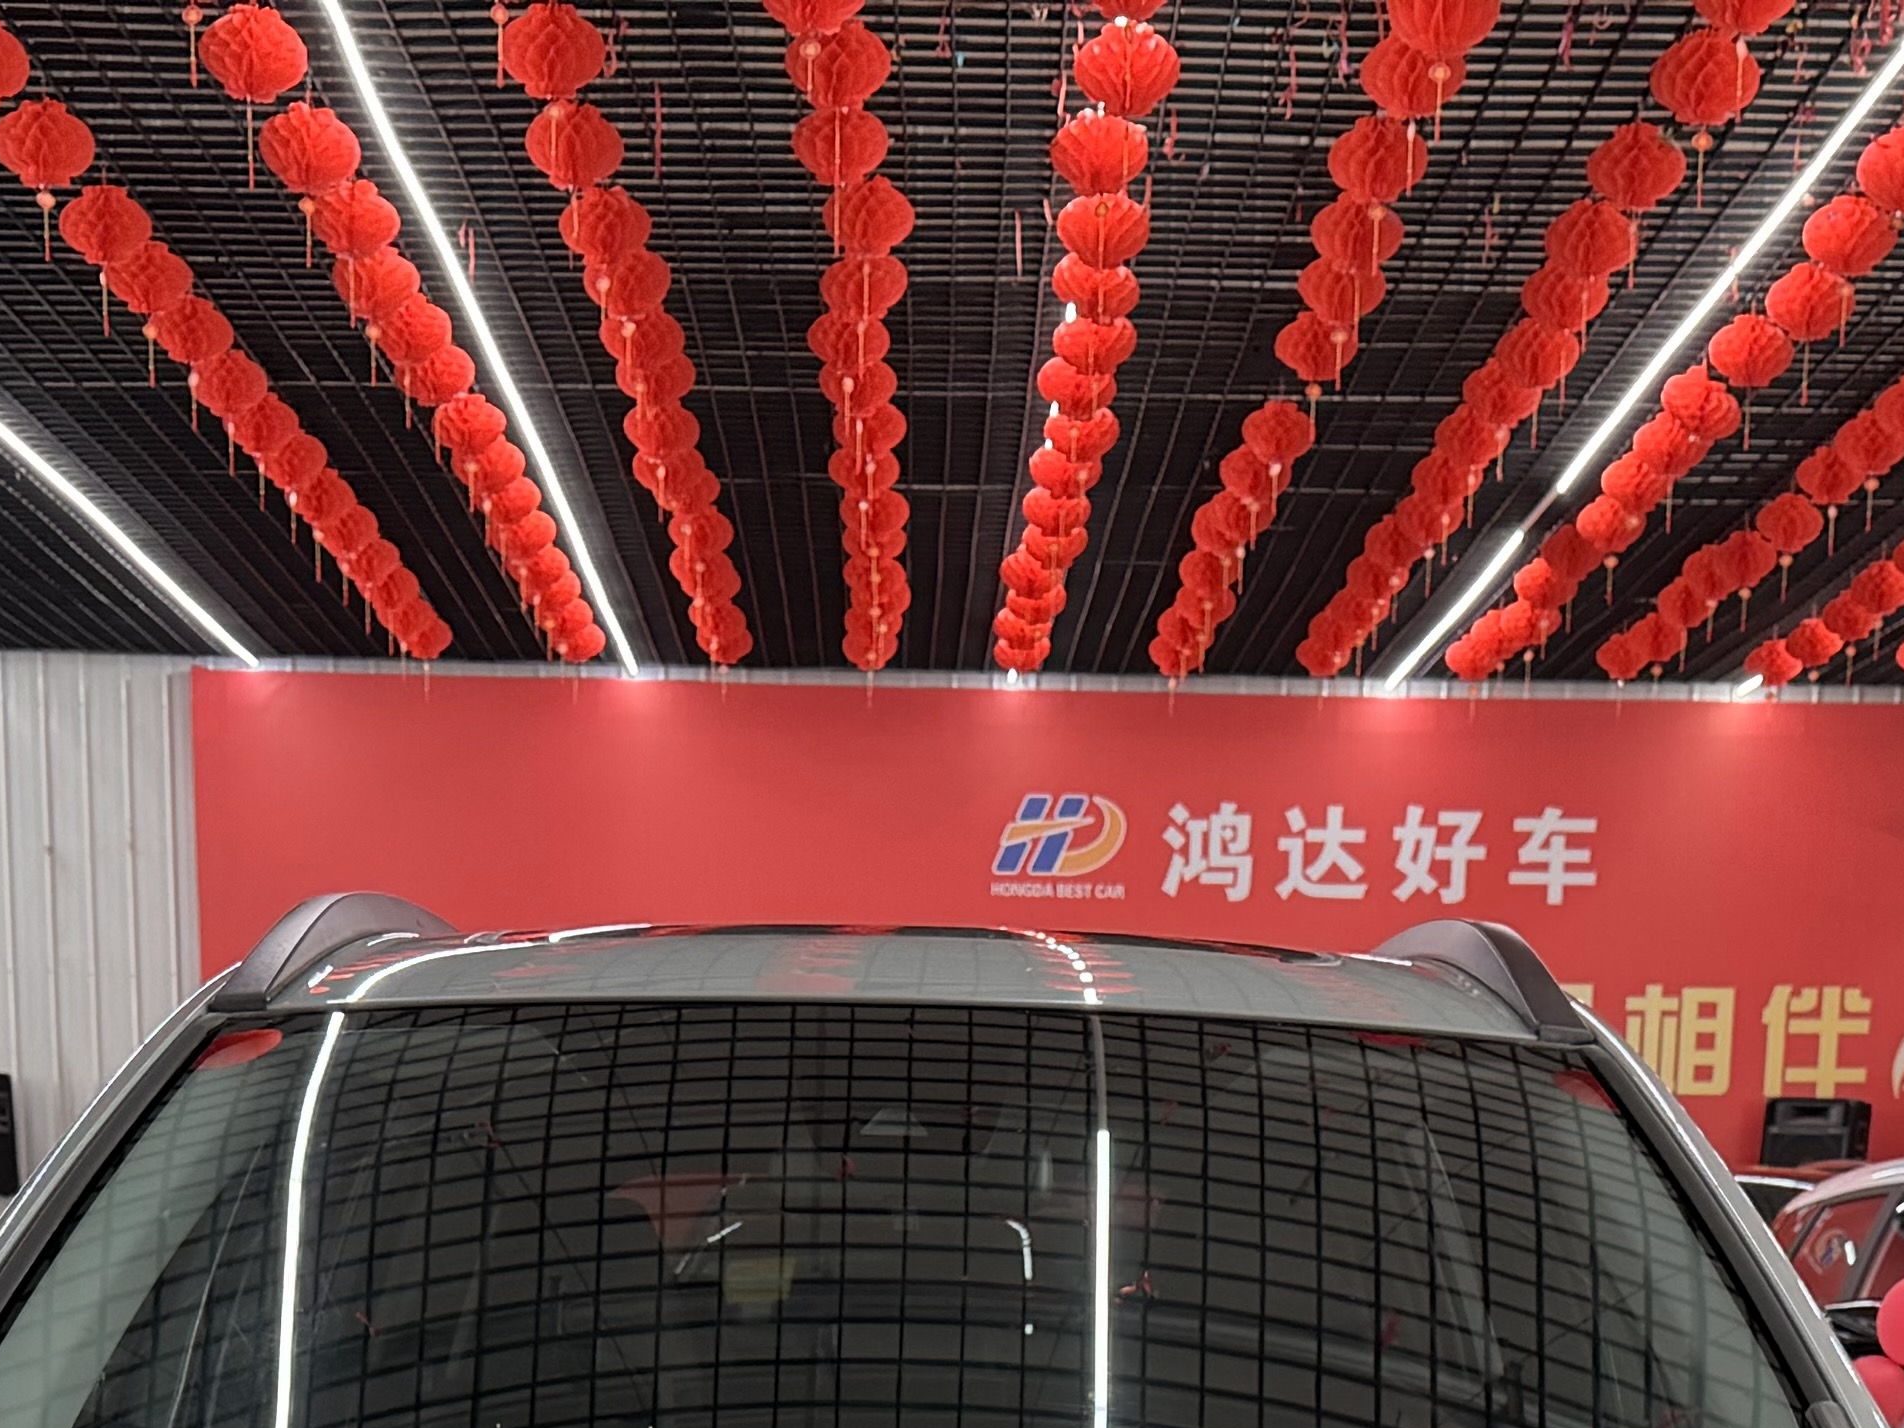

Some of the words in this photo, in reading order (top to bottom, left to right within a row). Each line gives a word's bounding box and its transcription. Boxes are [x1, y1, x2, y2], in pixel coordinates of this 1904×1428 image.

[990, 881, 1054, 898] HONGDA
[1056, 883, 1092, 899] BEST
[1094, 884, 1126, 900] CAR
[1161, 802, 1598, 906] 鸿达好车
[1560, 983, 1872, 1099] 相伴
